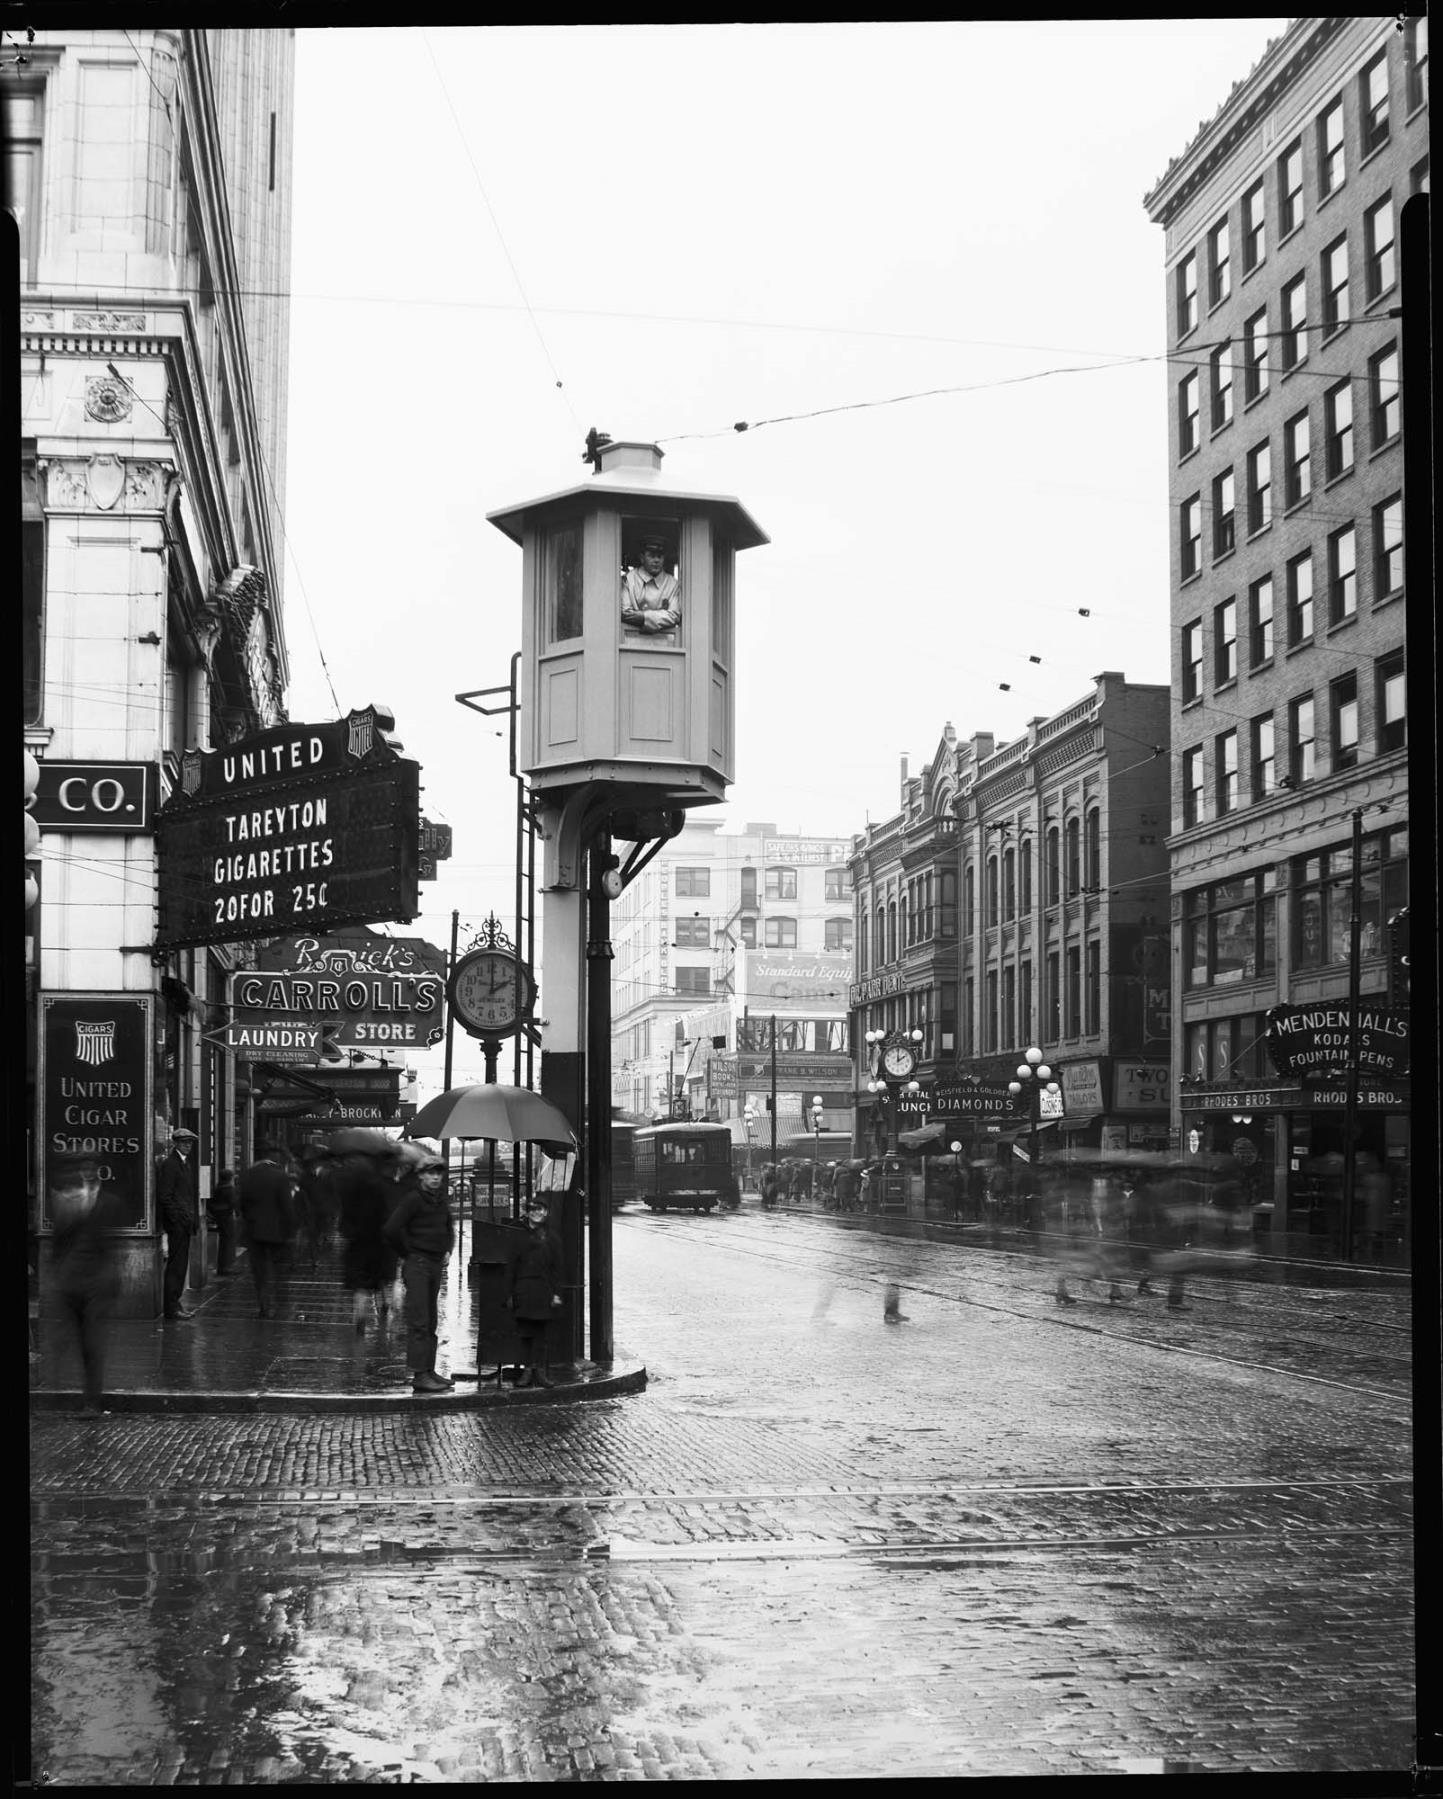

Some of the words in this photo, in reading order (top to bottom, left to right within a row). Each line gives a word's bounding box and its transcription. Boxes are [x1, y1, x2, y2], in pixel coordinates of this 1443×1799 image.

[224, 737, 324, 783] UNITED
[58, 777, 136, 813] CO.
[226, 799, 328, 842] TAREYTON
[755, 963, 817, 977] Standard
[240, 978, 440, 1012] CARROLL'S
[77, 1025, 112, 1035] CIGARS
[229, 1029, 319, 1048] LAUNDRY
[355, 1023, 416, 1040] STORE
[1314, 1034, 1371, 1046] KODAS
[1359, 1051, 1395, 1069] PENS
[60, 1077, 131, 1098] UNITED
[937, 1098, 1015, 1111] DIAMONDS
[1204, 1095, 1239, 1107] RHODES
[1246, 1093, 1272, 1106] BROS
[1313, 1091, 1364, 1104] RHODS
[64, 1104, 128, 1126] CIGAR
[52, 1132, 140, 1154] STORES
